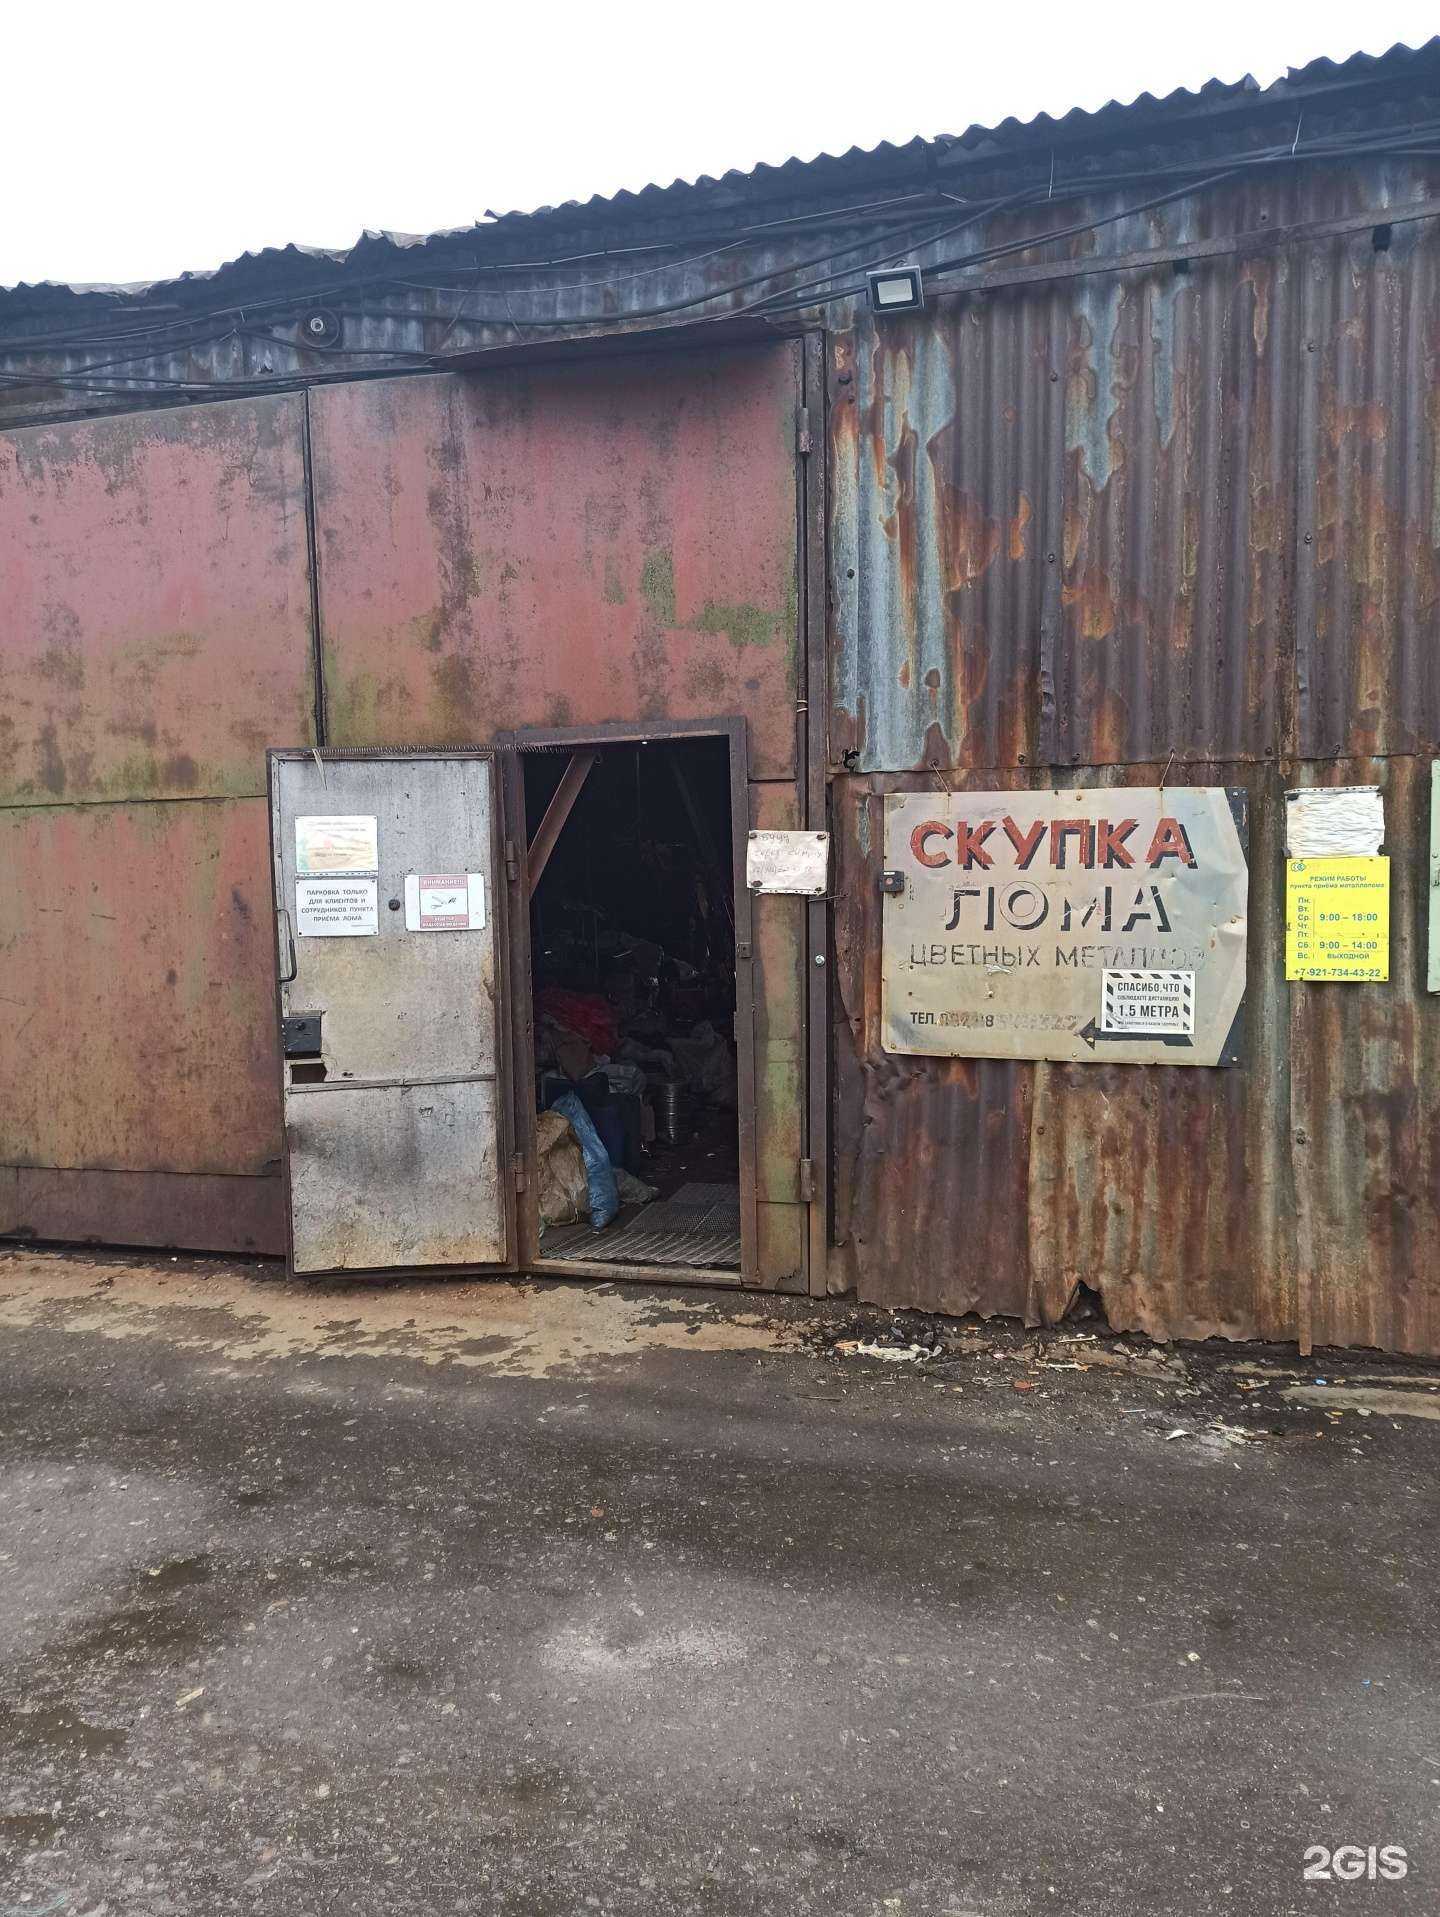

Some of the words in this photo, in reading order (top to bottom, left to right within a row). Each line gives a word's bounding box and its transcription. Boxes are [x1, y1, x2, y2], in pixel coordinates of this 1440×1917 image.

[910, 815, 1198, 871] СКУПКА
[944, 880, 1172, 932] ЛОМА
[1319, 913, 1341, 921] 9:00
[1352, 913, 1378, 921] 18:00
[1319, 941, 1341, 949] 9:00
[1352, 941, 1378, 949] 14:00
[909, 943, 1041, 967] ЦВЕТНЫХ
[1162, 983, 1180, 993] ЧТО
[1119, 1004, 1136, 1017] 1.5
[1140, 1005, 1179, 1018] МЕТРА
